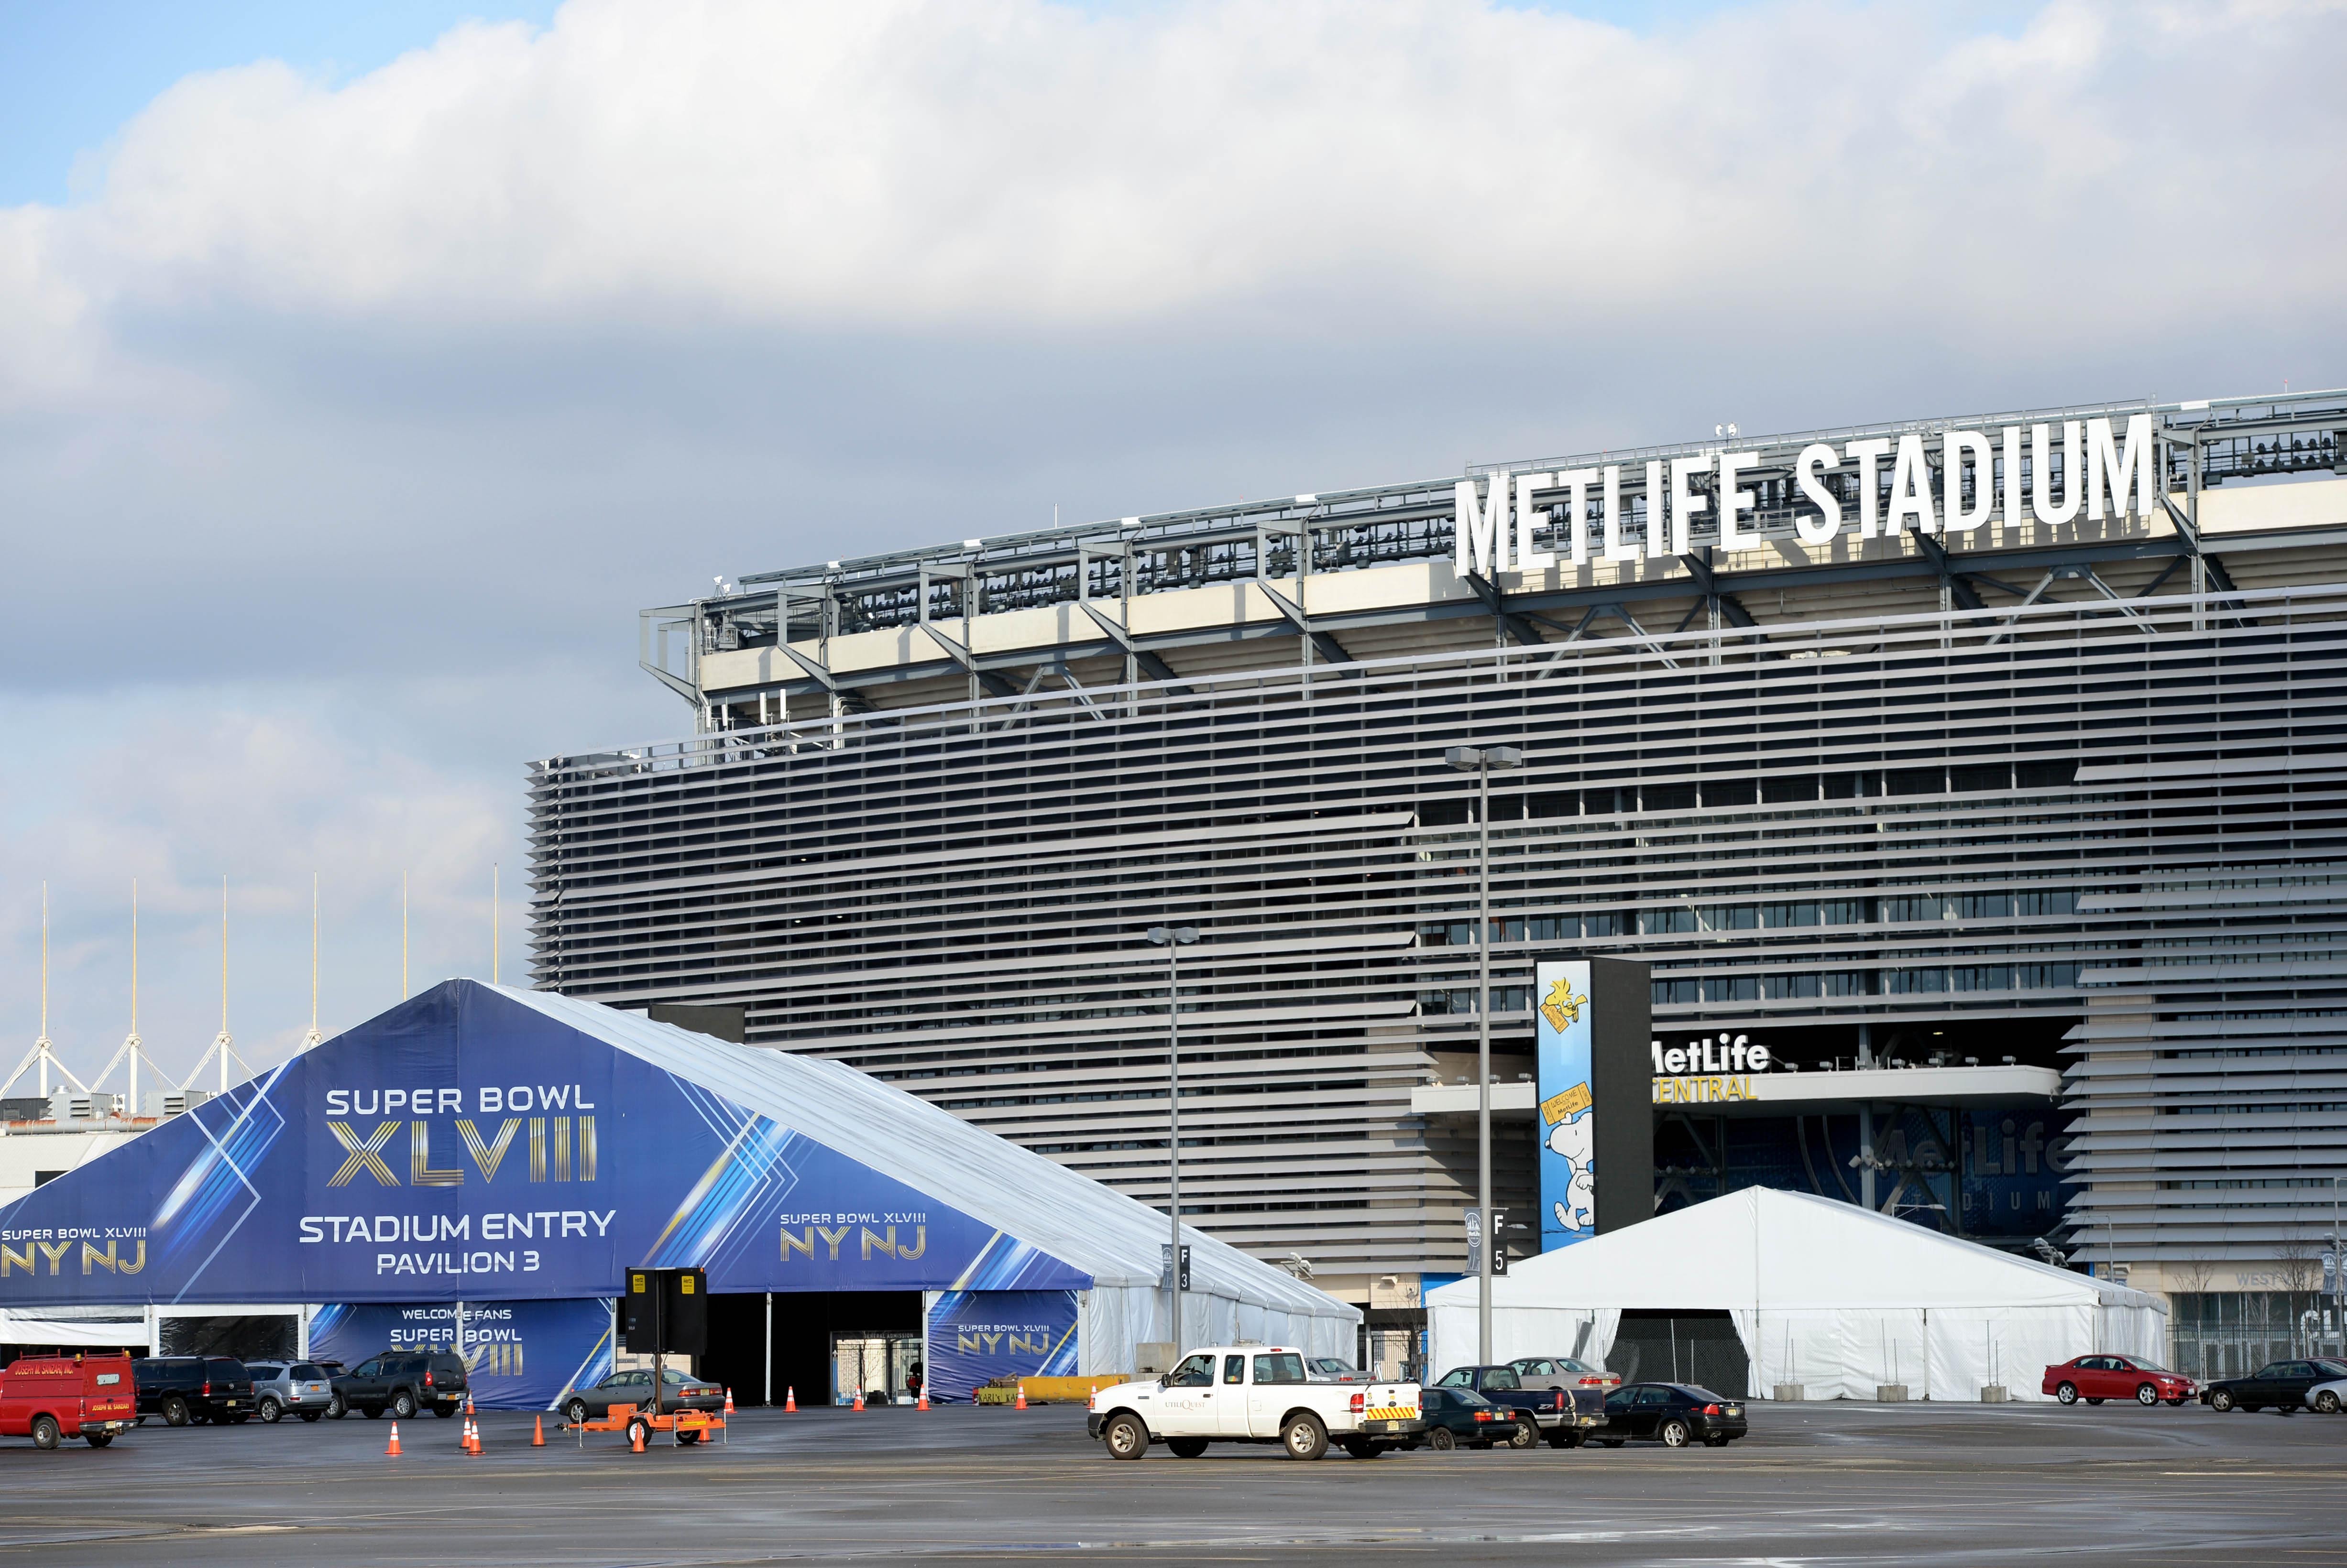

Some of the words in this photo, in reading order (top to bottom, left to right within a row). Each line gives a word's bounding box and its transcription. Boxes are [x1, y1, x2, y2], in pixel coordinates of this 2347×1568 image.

[1455, 451, 1762, 577] METLIFE
[1796, 414, 2153, 545] STADIUM
[327, 1089, 462, 1115] SUPER
[480, 1085, 594, 1112] BOWL
[1551, 1090, 1578, 1108] WELCOME
[1652, 1077, 1758, 1103] ENTRAL
[1557, 1101, 1579, 1114] MetLife
[326, 1115, 596, 1187] XLVIII
[1895, 1191, 2051, 1212] TADIUM
[299, 1215, 470, 1242] STADIUM
[482, 1210, 616, 1240] ENTRY
[780, 1213, 831, 1224] SUPER
[836, 1213, 879, 1223] BOWL
[884, 1213, 925, 1223] XLVIII
[1494, 1215, 1503, 1234] F
[2, 1229, 53, 1241] SUPER
[58, 1228, 100, 1239] BOWL
[105, 1227, 146, 1238] XLVIII
[780, 1226, 851, 1262] NY
[861, 1225, 926, 1261] NJ
[1, 1241, 72, 1277] NY
[82, 1240, 146, 1275] NJ
[377, 1251, 514, 1274] PAVILION
[523, 1251, 540, 1271] 3
[1181, 1249, 1188, 1263] F
[1495, 1250, 1503, 1270] 5
[1181, 1274, 1187, 1287] 3
[2236, 1272, 2277, 1285] WEST
[402, 1309, 472, 1321] WELCOME
[475, 1309, 512, 1320] FANS
[390, 1328, 454, 1342] SUPER
[465, 1328, 522, 1342] BOWL
[958, 1333, 1003, 1355] NY
[1009, 1333, 1049, 1355] NJ
[15, 1365, 33, 1375] JOSEPH
[391, 1343, 523, 1377] VIII
